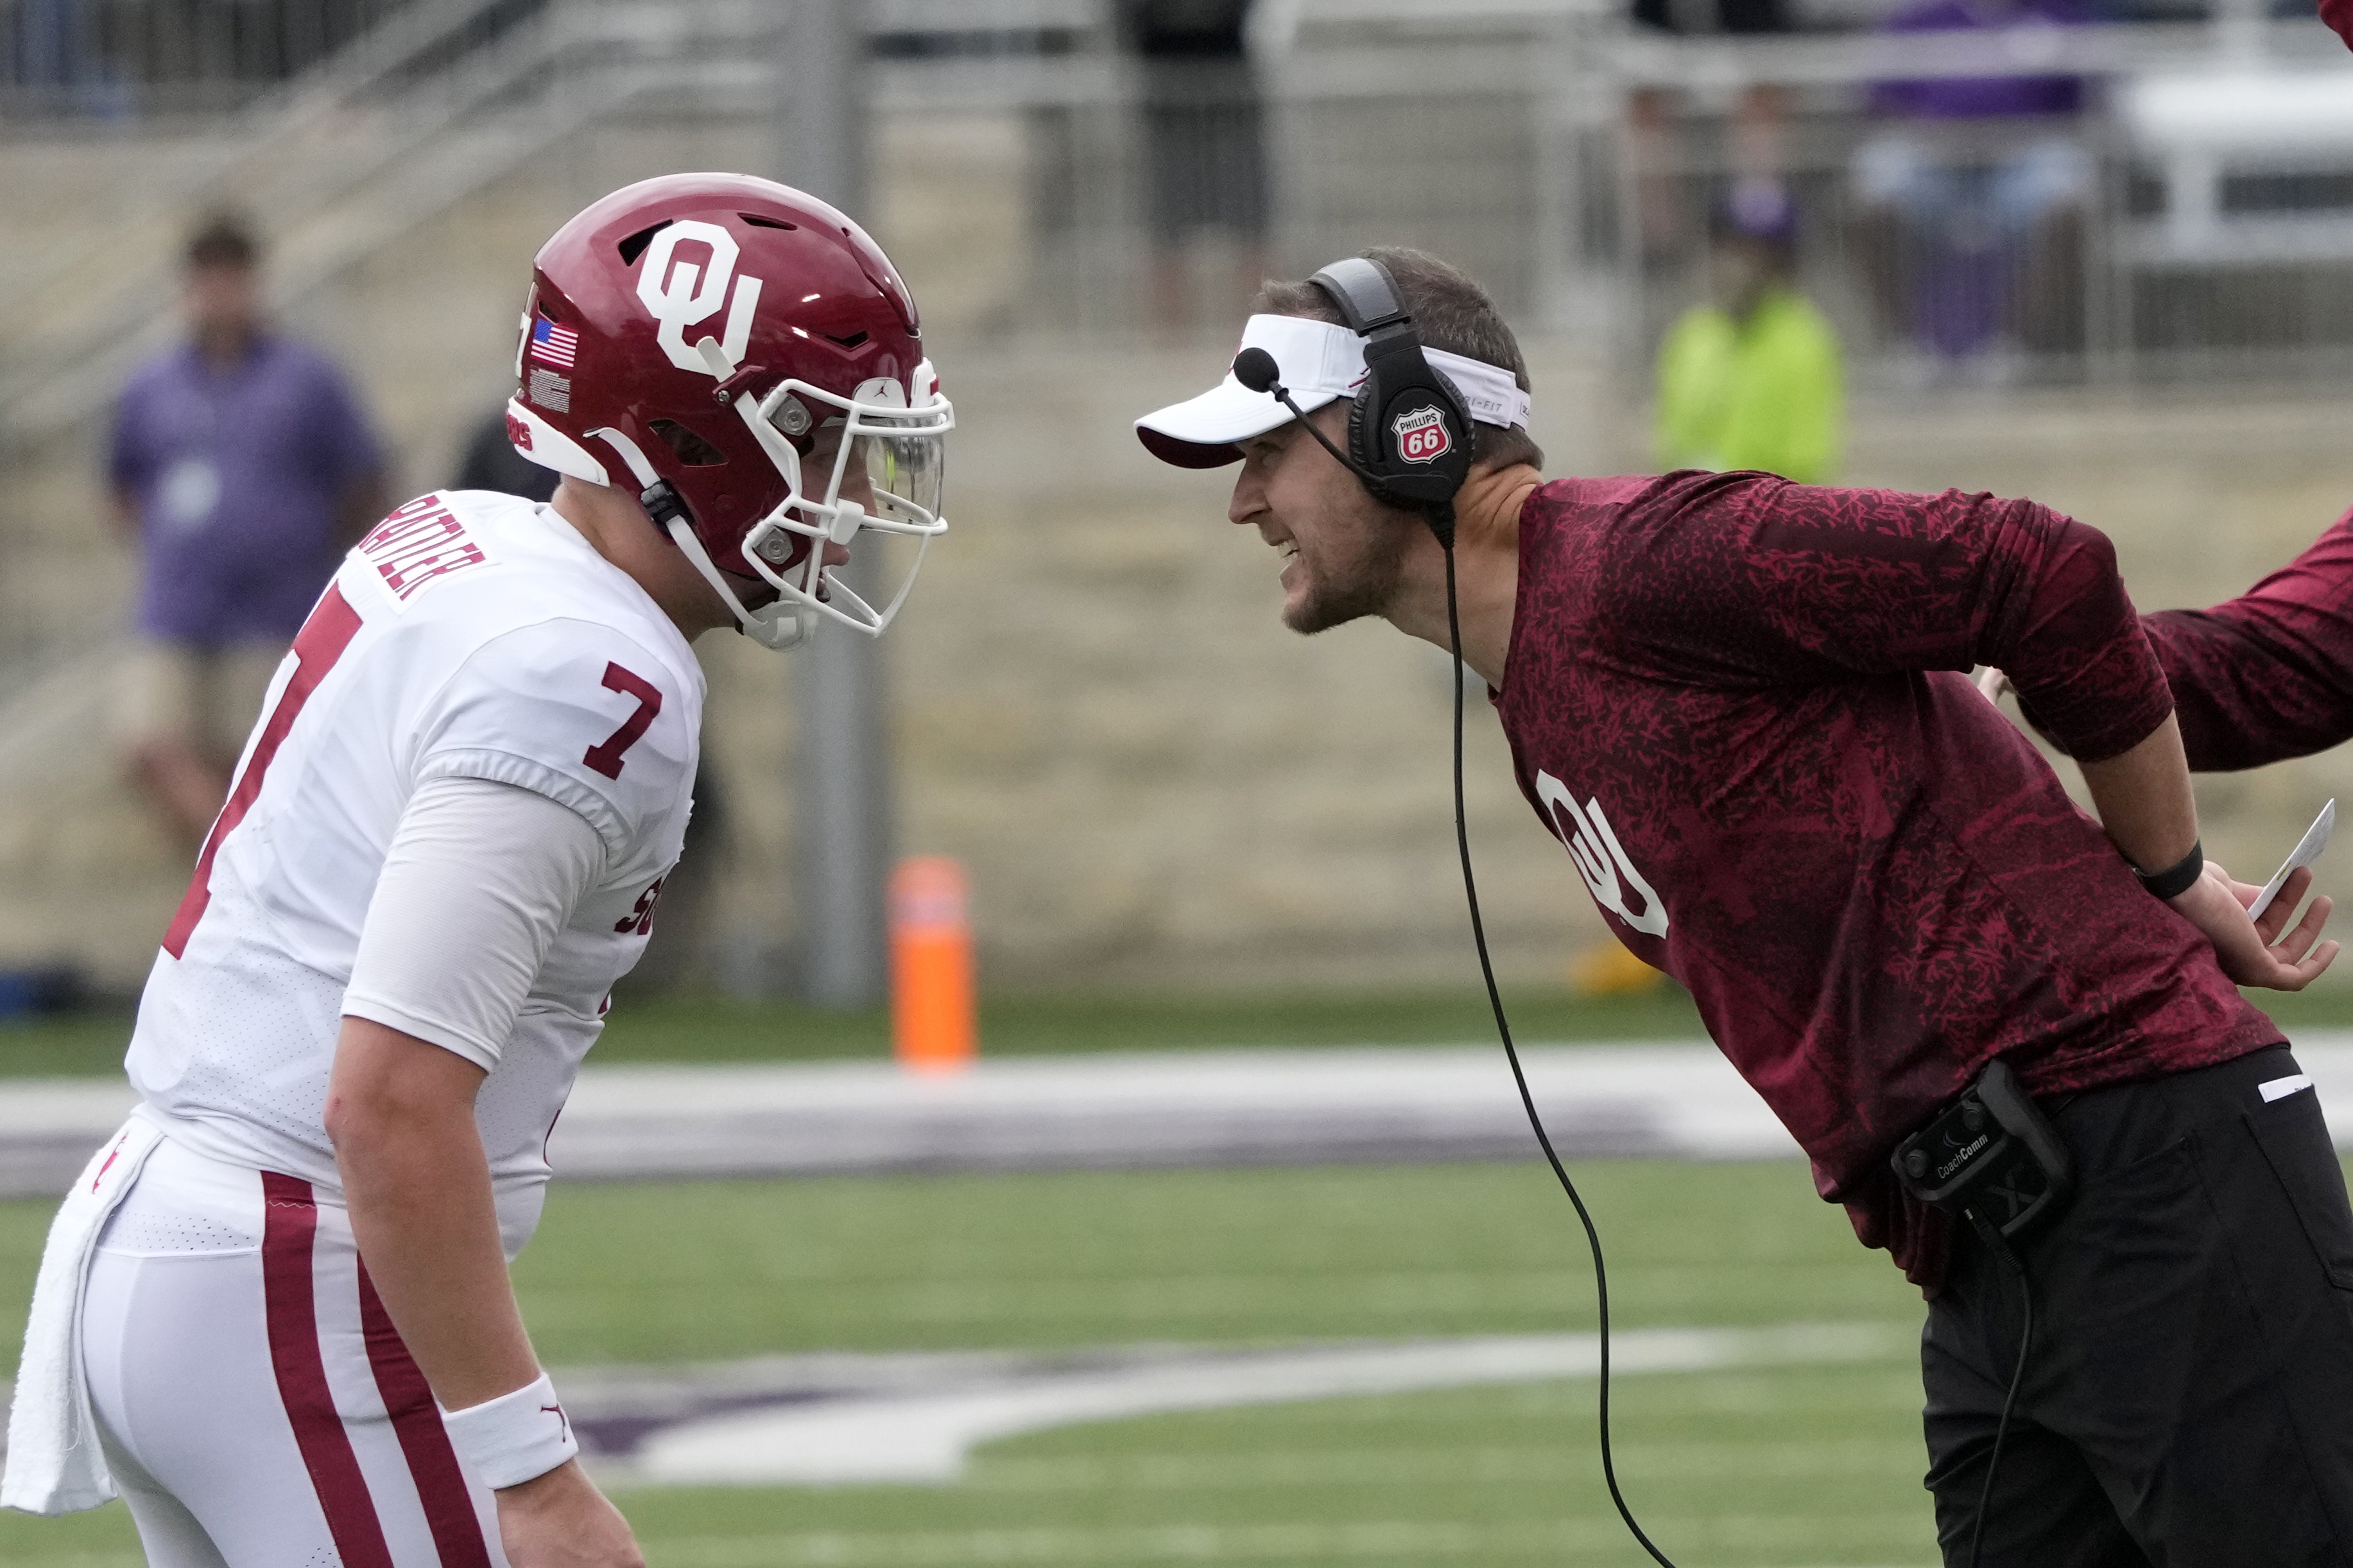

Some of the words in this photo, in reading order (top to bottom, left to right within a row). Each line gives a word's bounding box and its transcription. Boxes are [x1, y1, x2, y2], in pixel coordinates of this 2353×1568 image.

[636, 220, 763, 376] OU
[1400, 413, 1437, 432] PHILLIPS
[1408, 429, 1438, 454] 66
[161, 578, 363, 961] 7
[582, 660, 662, 780] 7
[1535, 768, 1670, 940] OU
[1937, 1133, 1989, 1179] CoachComm
